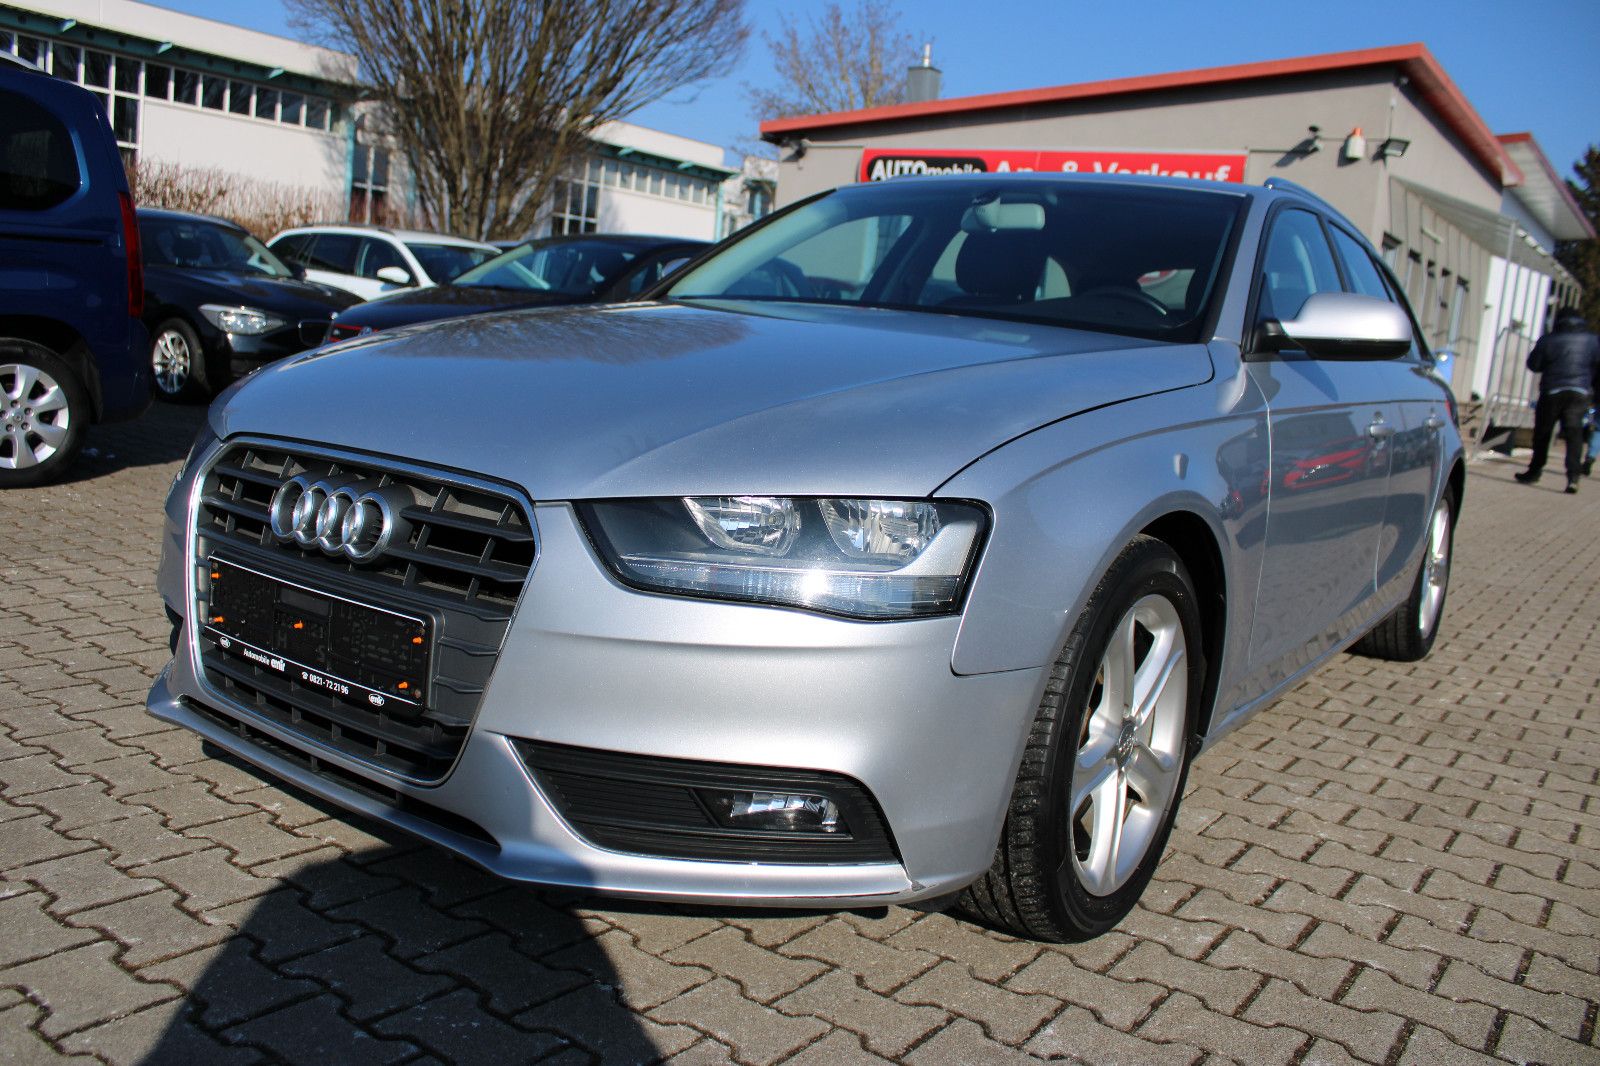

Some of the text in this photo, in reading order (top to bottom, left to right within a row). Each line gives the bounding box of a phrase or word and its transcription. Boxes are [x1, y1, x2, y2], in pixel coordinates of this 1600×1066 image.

[996, 160, 1033, 173] A
[1093, 161, 1231, 182] Vkuf
[243, 648, 286, 672] Automobile emir
